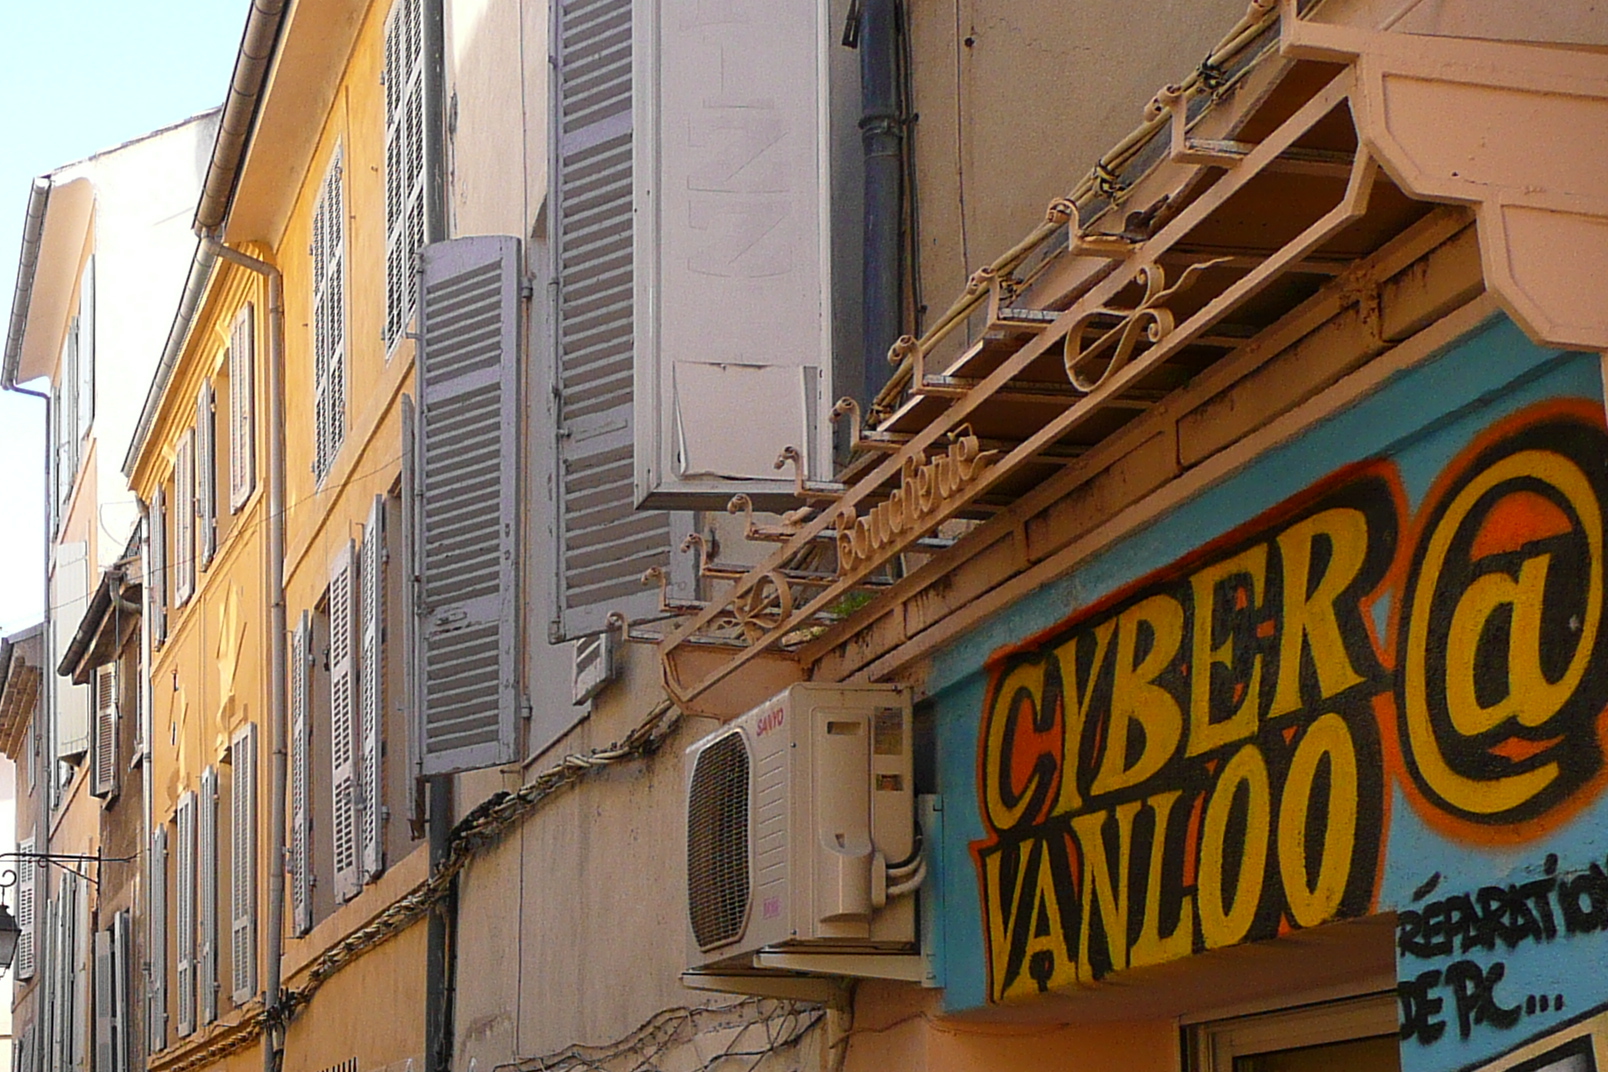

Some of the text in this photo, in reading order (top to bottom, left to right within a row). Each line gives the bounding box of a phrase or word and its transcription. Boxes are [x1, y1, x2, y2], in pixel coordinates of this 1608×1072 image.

[756, 707, 784, 737] SANYO
[986, 507, 1368, 831] CYBER
[986, 712, 1359, 1002] VANLOO
[1397, 969, 1447, 1046] DE
